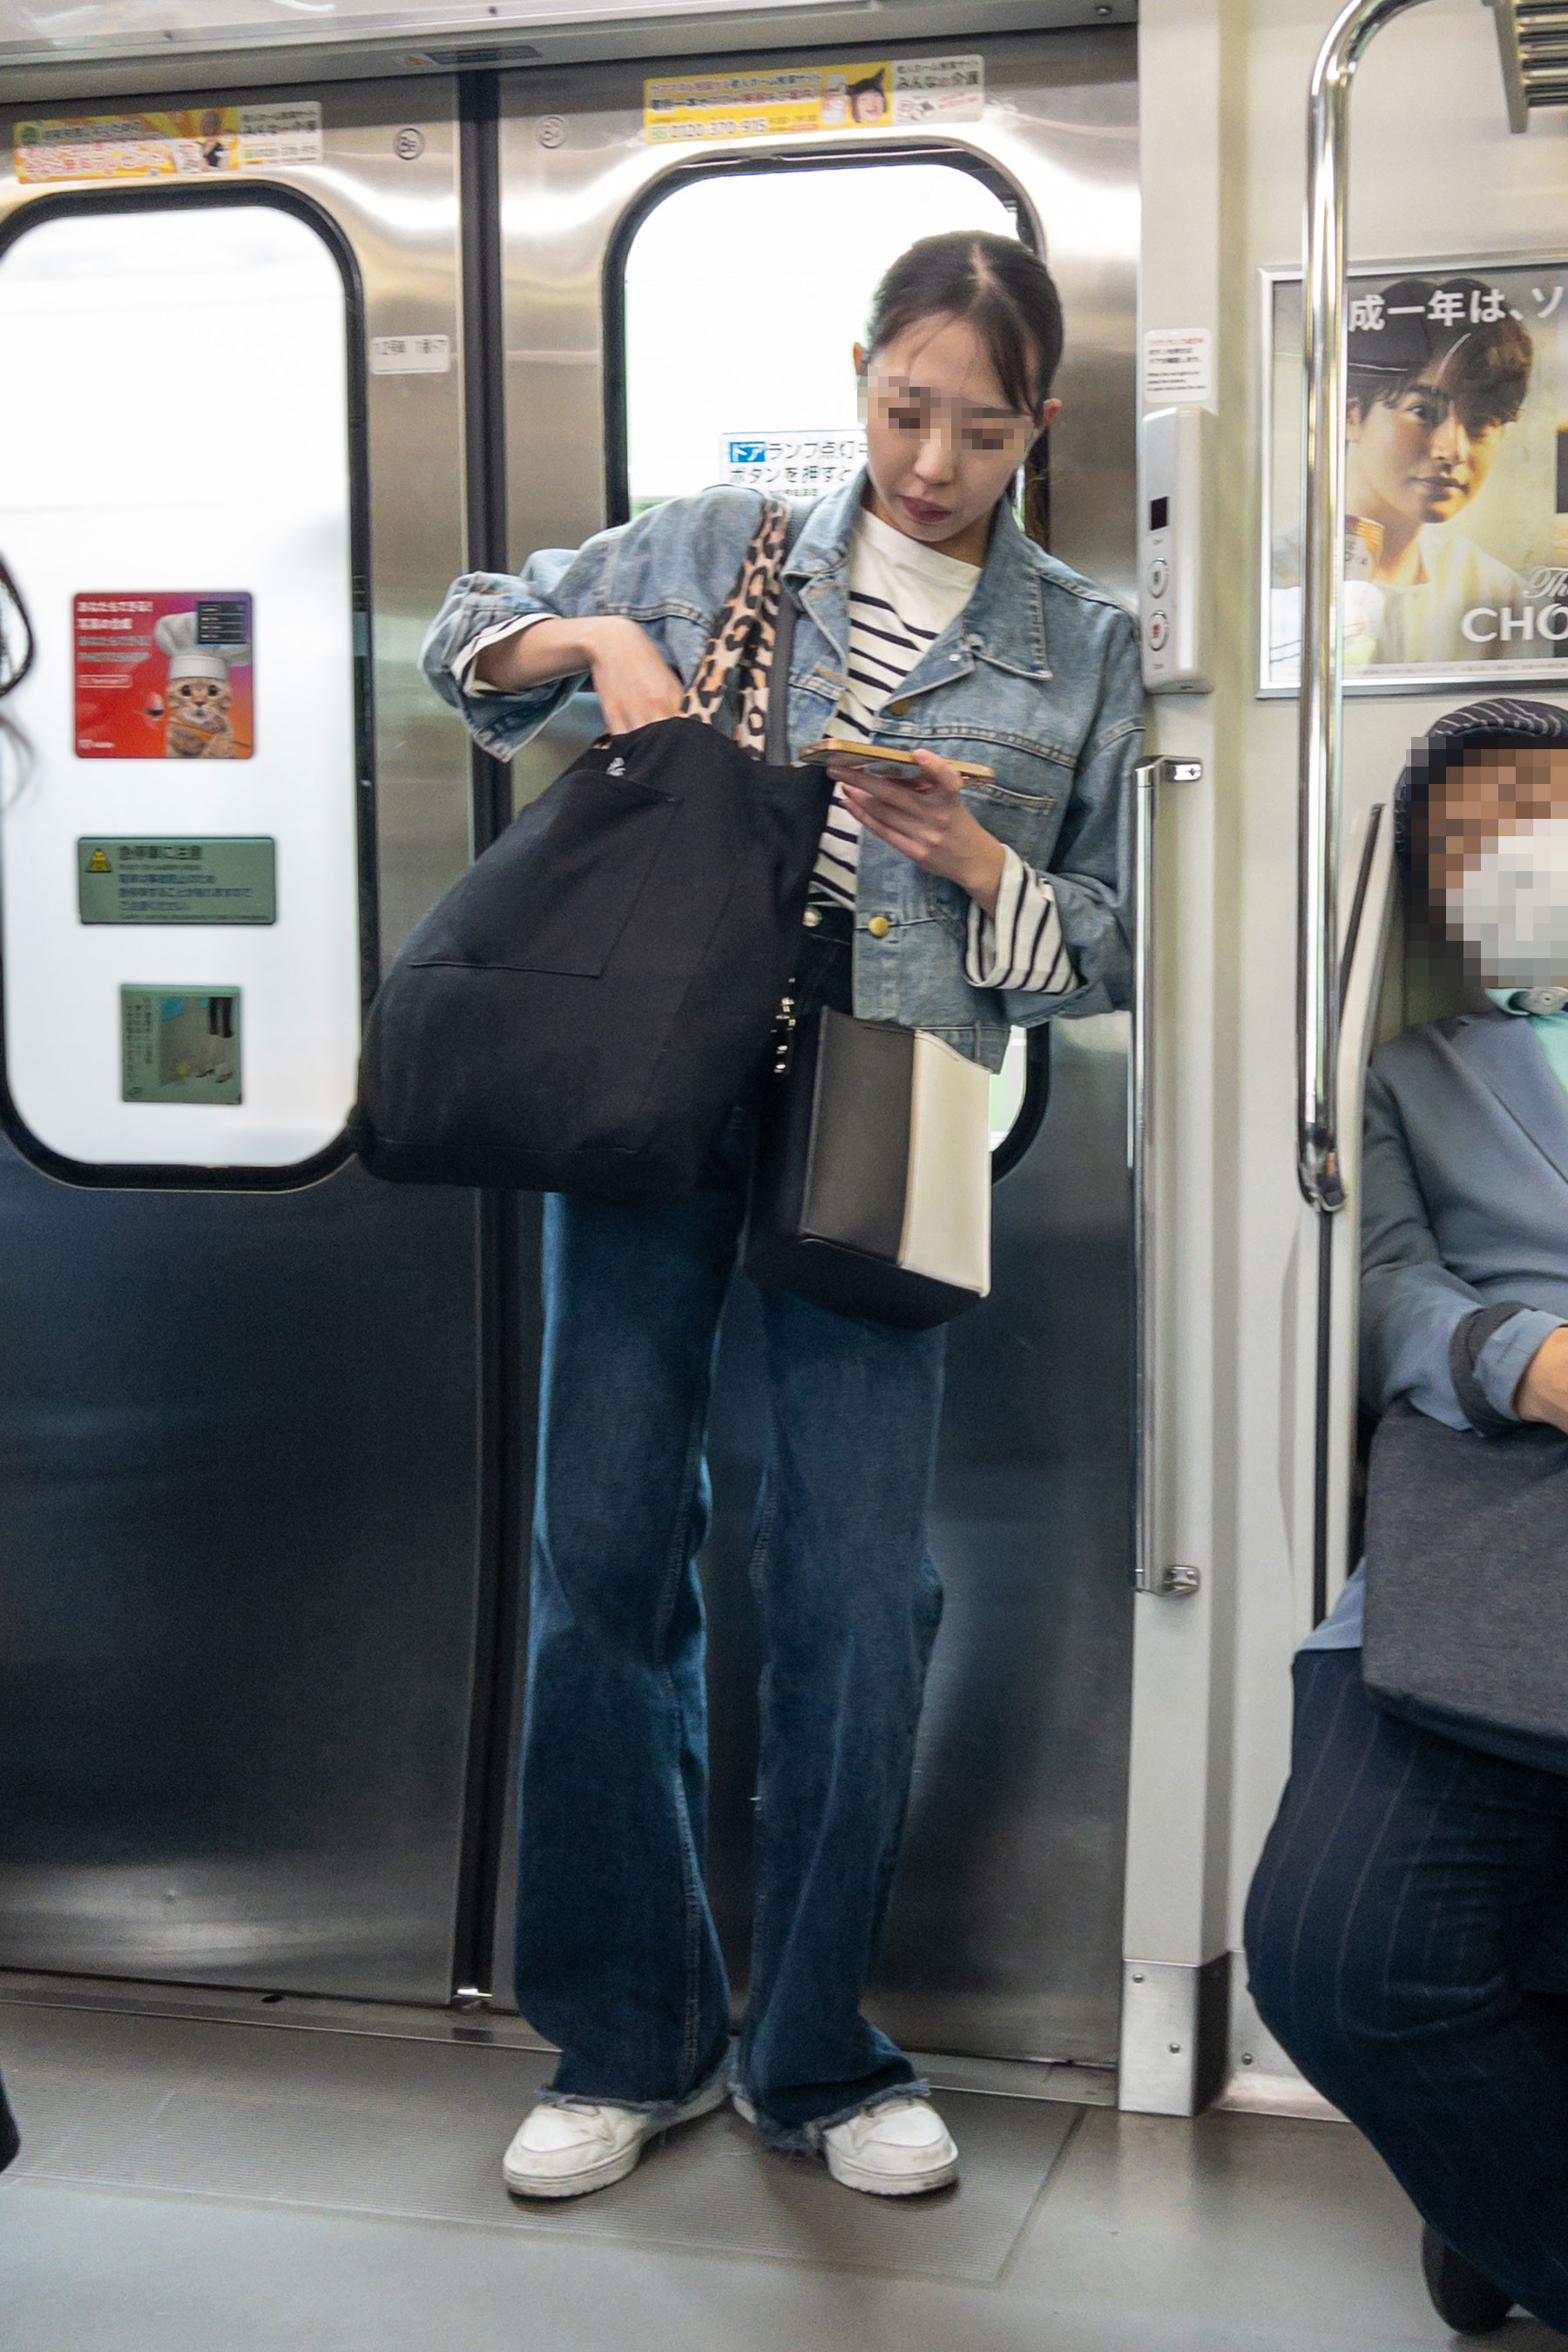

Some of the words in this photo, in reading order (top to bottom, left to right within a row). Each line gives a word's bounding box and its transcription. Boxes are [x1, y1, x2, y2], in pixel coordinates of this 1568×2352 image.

[1348, 286, 1565, 332] 成一年は、ソ
[1522, 566, 1568, 598] Th
[1462, 603, 1568, 643] CHO
